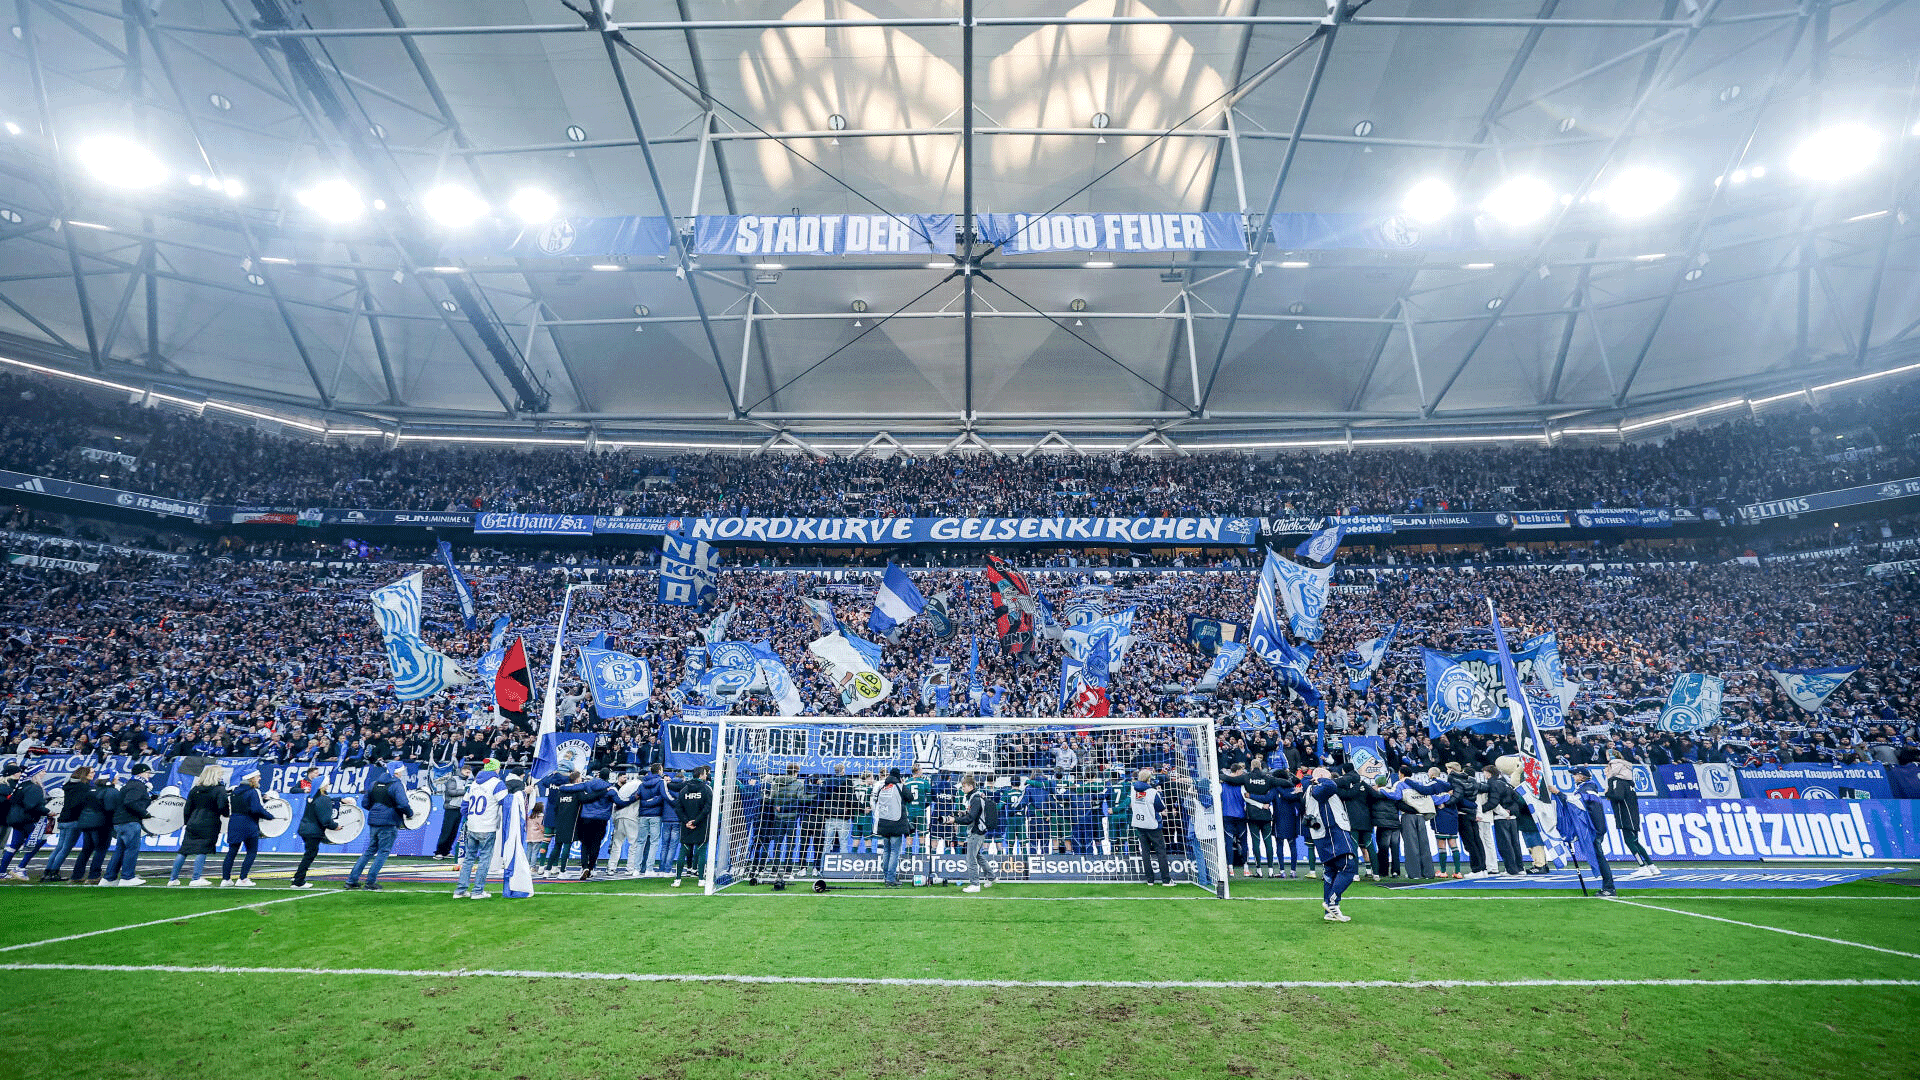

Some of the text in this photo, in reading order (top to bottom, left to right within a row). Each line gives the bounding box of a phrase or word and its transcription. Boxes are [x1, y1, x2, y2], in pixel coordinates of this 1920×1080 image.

[736, 214, 910, 253] STADT DER
[1015, 213, 1206, 251] 1000 FEUER
[136, 497, 200, 516] FC Schalke 04
[1737, 498, 1810, 520] VELTINS
[394, 514, 470, 524] SUN MINIMEAL
[607, 520, 667, 531] HAMBURG
[1392, 517, 1470, 526] SUN MINIMEAL
[1519, 513, 1562, 523] Delbrück
[1594, 516, 1627, 524] RÜTHEN
[691, 516, 1224, 544] NORDKURVE GELSENKIRCHEN
[668, 723, 713, 756] WIR
[819, 730, 901, 758] SIEGEN!
[1249, 778, 1266, 786] HRS
[1804, 769, 1844, 780] Knappen
[1844, 769, 1867, 779] 2002
[1867, 769, 1884, 779] e.V.
[684, 792, 702, 800] HRS
[910, 784, 919, 800] 5
[1113, 788, 1123, 804] 7
[469, 795, 488, 816] 20
[1135, 813, 1145, 822] 03
[823, 854, 924, 873] Eisenbch
[1028, 856, 1128, 874] Eisenbach
